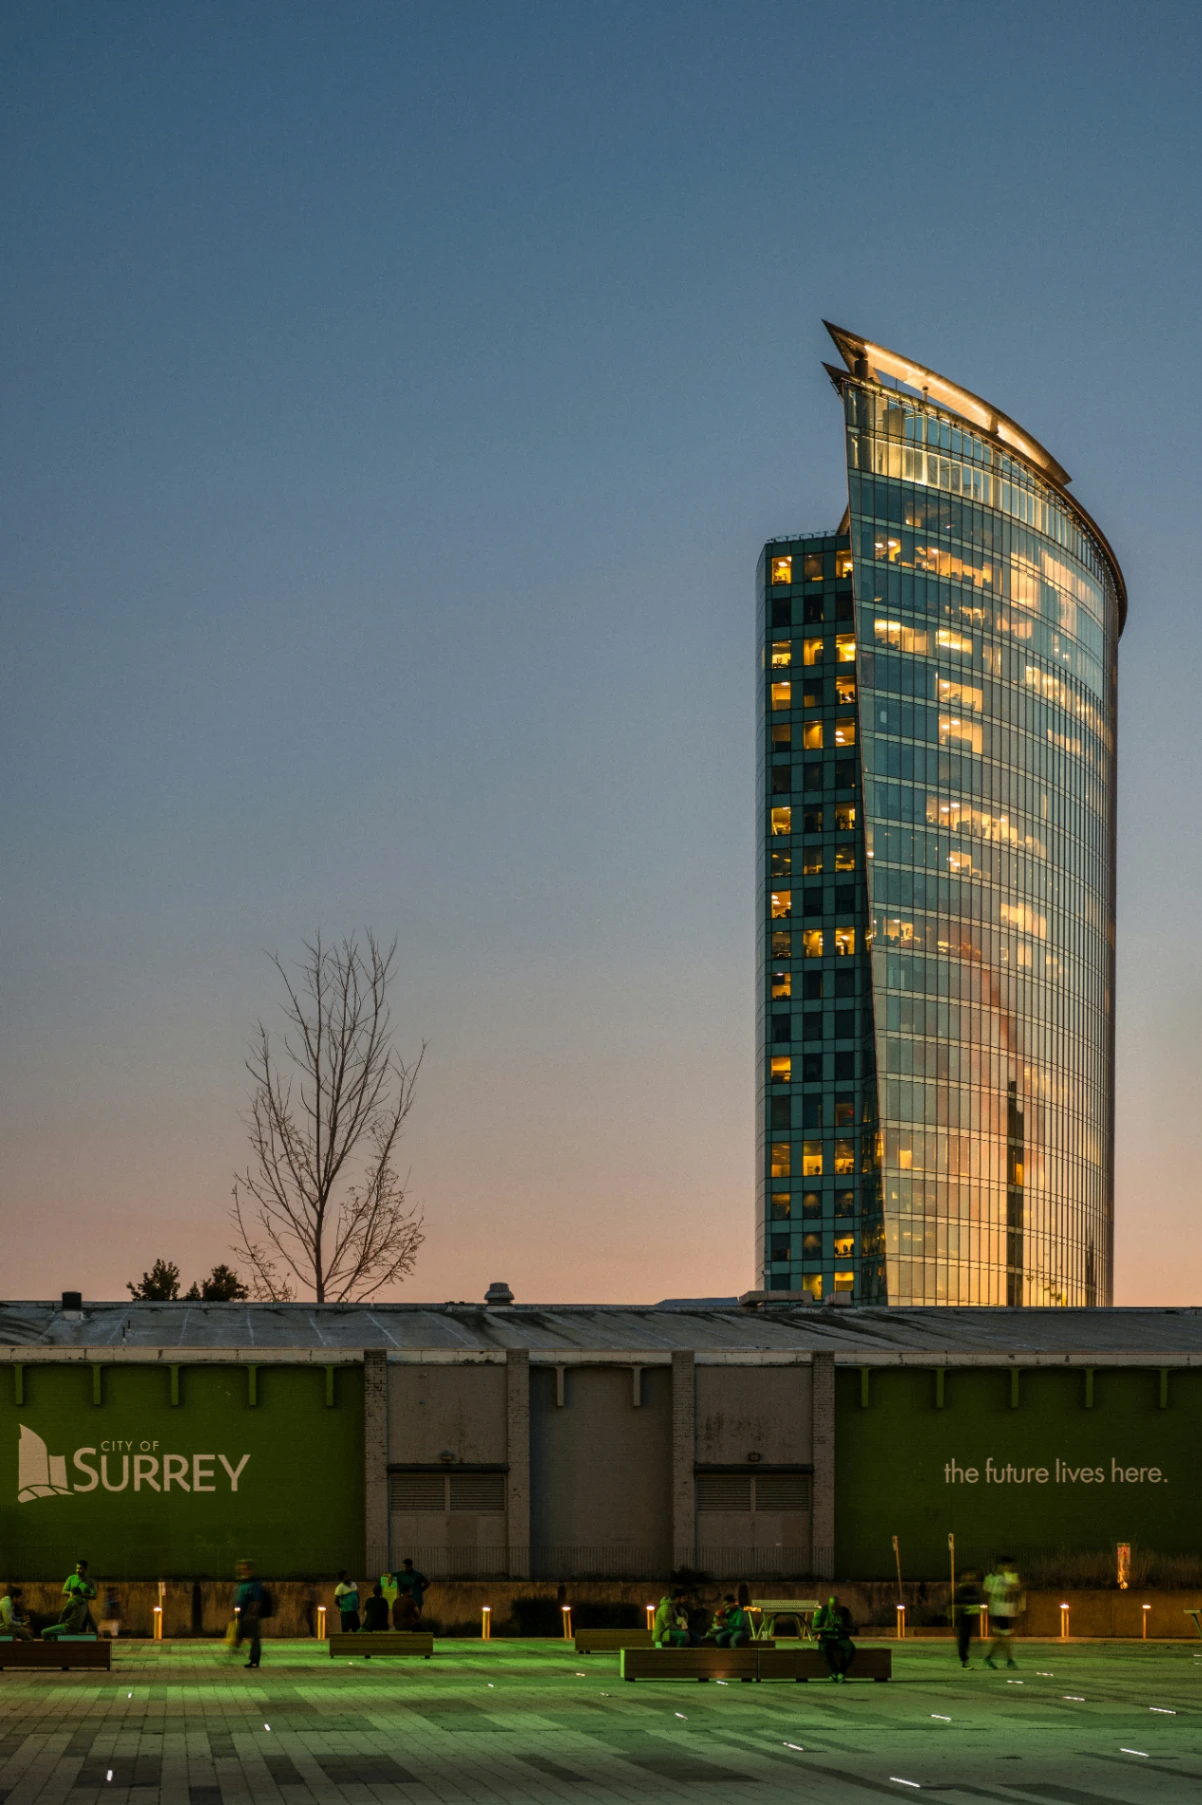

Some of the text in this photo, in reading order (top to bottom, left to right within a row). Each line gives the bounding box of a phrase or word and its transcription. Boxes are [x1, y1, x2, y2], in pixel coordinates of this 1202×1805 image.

[100, 1440, 160, 1452] CITY OF
[73, 1447, 250, 1492] SURREY
[944, 1457, 1168, 1484] the future lives here.
